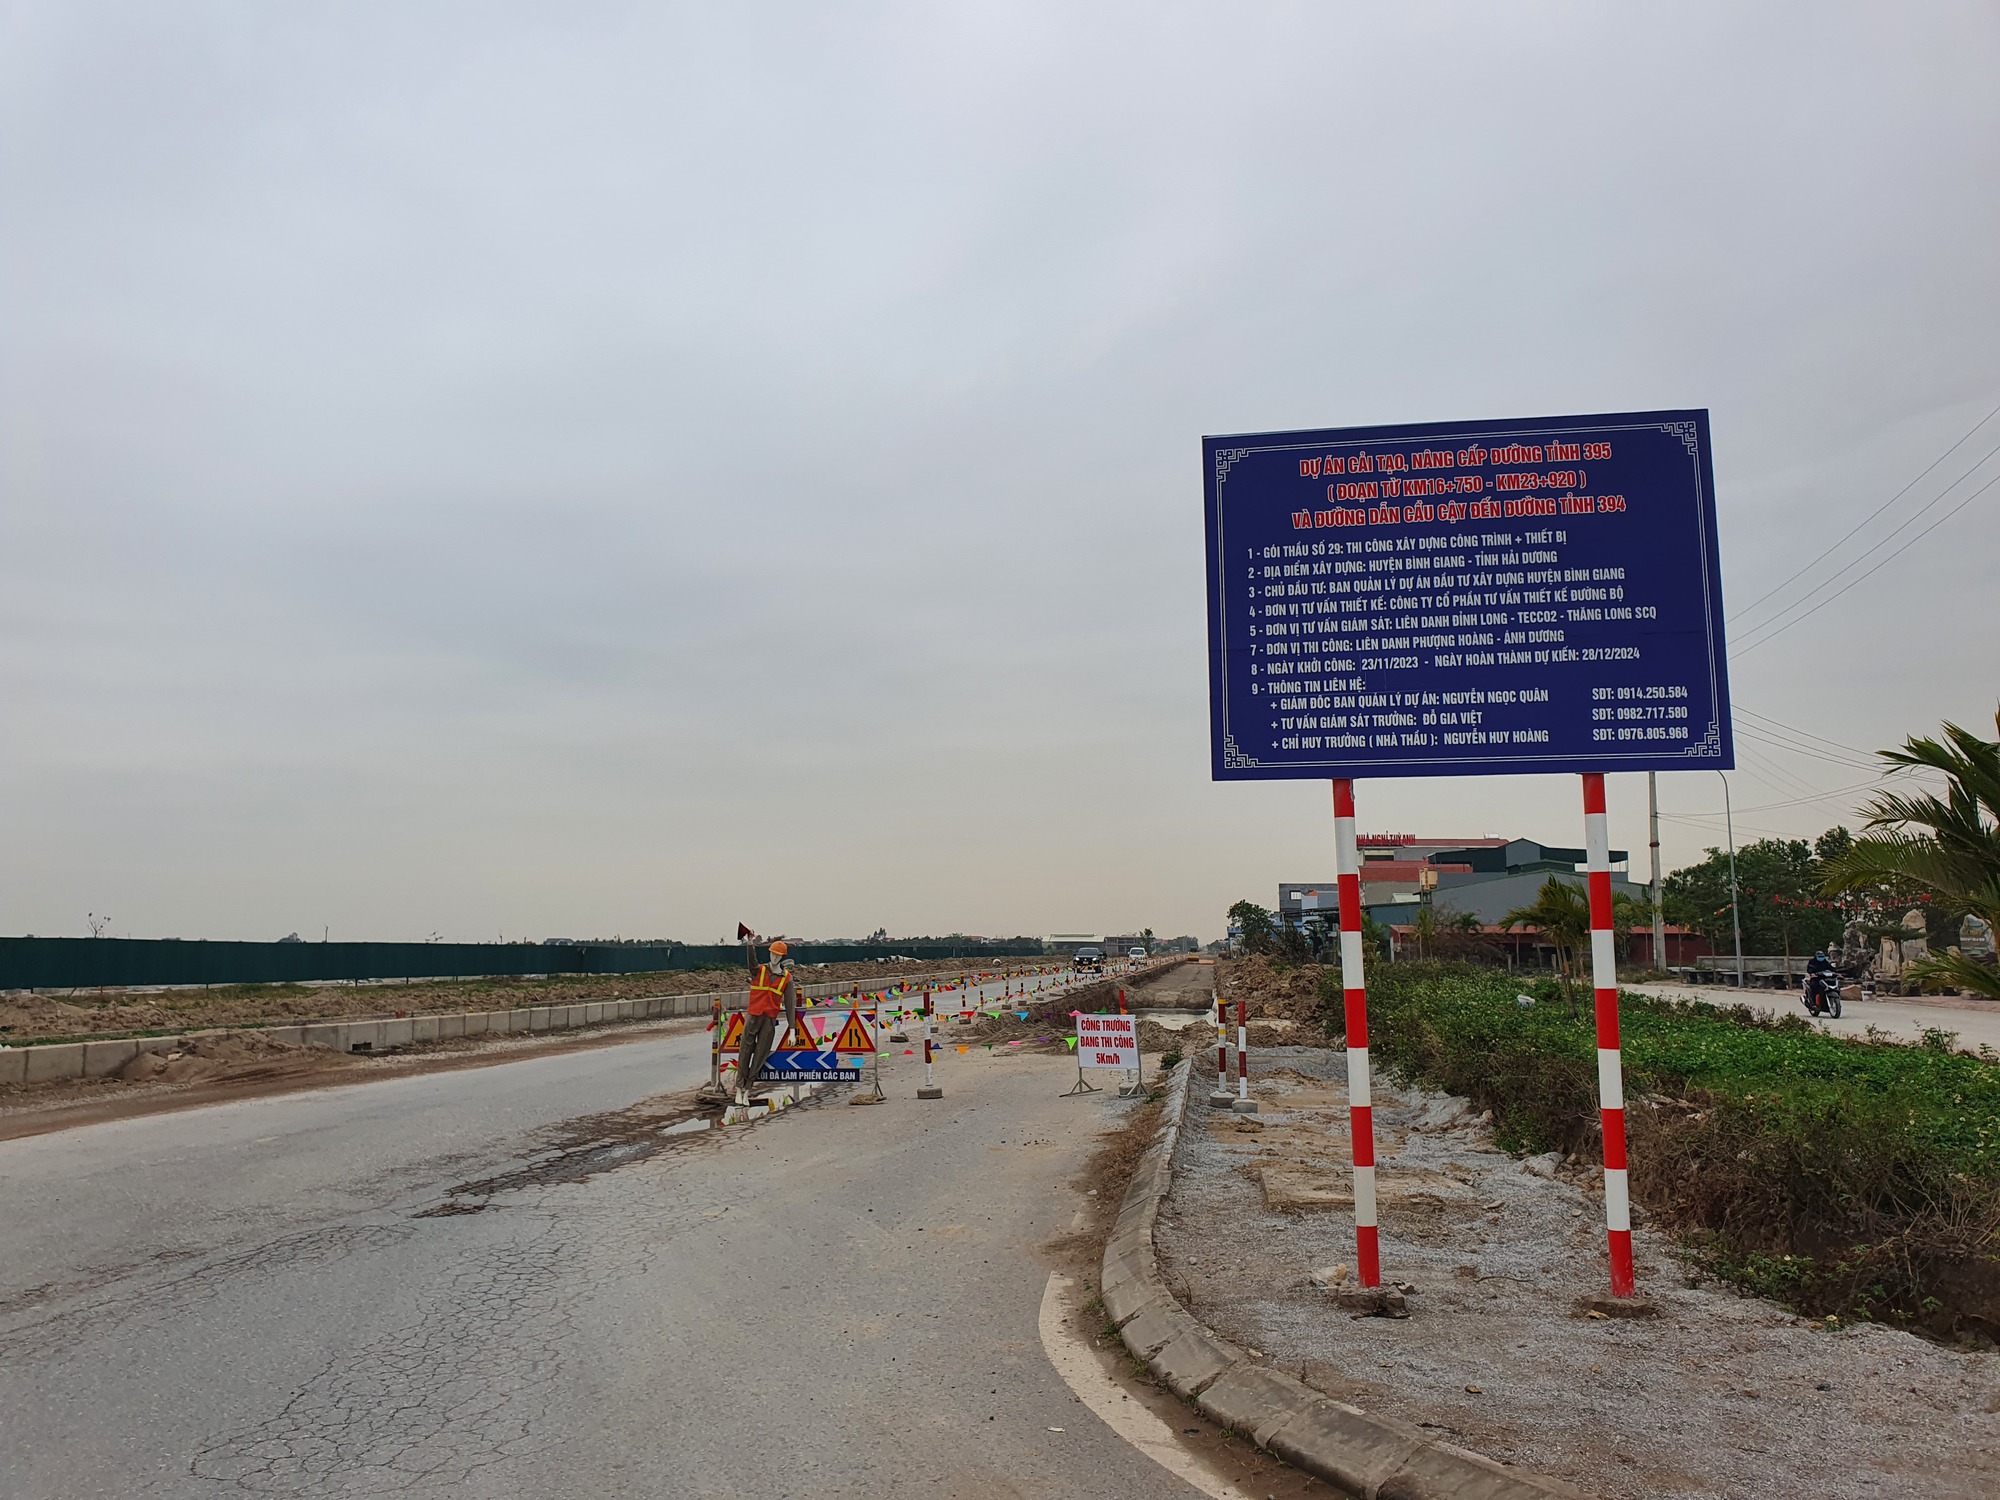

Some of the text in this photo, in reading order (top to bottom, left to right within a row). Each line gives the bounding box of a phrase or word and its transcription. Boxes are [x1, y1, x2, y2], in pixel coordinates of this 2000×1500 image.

[1300, 440, 1611, 477] DỰ ÁN CẢI TẠO, NÂNG CẤP ĐƯỜNG TỈNH 395
[1337, 471, 1576, 501] ĐOẠN TỪ KM16+750 KM23+920
[1292, 492, 1626, 528] VÀ ĐƯỜNG DẪN CẦU CẬY ĐẾN ĐƯỜNG TỈNH 394
[1263, 527, 1553, 558] GÓI THẦU 29: THI CÔNG XÂY DỰNG CÔNG TRÌNH THIẾT
[1263, 549, 1557, 580] ĐỊA ĐIỂM XÂY DỰNG: HUYỆN BÌNH GIANG TỈNH HẢI DƯƠNG
[1264, 567, 1625, 597] CHỦ ĐẦU TƯ: BAN QUẢN DỰ ÁN ĐẦU TƯ XÂY DỰNG HUYỆN BÌNH GIANG
[1264, 584, 1623, 616] ĐƠN TƯ VẤN THIẾT KẾ: CÔNG CỔ TƯ VẤN THIẾT KẾ ĐƯỜNG BỘ
[1265, 622, 1287, 636] ĐƠN
[1301, 620, 1316, 634] TƯ
[1317, 616, 1338, 633] VẤN
[1341, 617, 1368, 632] GIÁM
[1370, 615, 1392, 630] SÁT:
[1395, 614, 1418, 629] LIÊN
[1421, 615, 1450, 628] DANH
[1452, 610, 1477, 626] ĐỈNH
[1480, 612, 1508, 625] LONG
[1566, 606, 1601, 621] THĂNG
[1604, 607, 1632, 620] LONG
[1634, 606, 1656, 619] SCQ
[1266, 629, 1564, 655] ĐƠN THI CÔNG: LIÊN DANH PHƯỢNG HOÀNG ÁNH DƯƠNG
[1267, 645, 1640, 674] NGÀY KHỞI CÔNG: 23/11/2023 NGÀY HOÀN THÀNH DỰ KIẾN: 28/12/2024
[1267, 675, 1366, 694] THÔNG TIN LIÊN HỆ:
[1592, 686, 1688, 700] SĐT: 0914.250.584
[1280, 687, 1548, 710] GIÁM BAN DỰ ÁN: NGUYỄN NGỌC QUÂN
[1280, 708, 1482, 730] TƯ VẤN GIÁM SÁT TRƯỞNG: ĐỖ GIA VIỆT
[1592, 706, 1688, 720] SĐT: 0982.717.580
[1281, 727, 1549, 749] CHỈ HUY TRƯỞNG NHÀ THẦU NGUYỄN HUY HOÀNG
[1592, 726, 1688, 741] SĐT: 0976.805.968
[1081, 1017, 1131, 1032] CÔNG TRƯỜNG
[1080, 1034, 1134, 1048] ĐANG THI CÔNG
[1096, 1053, 1120, 1065] 5Km/h
[823, 1069, 838, 1080] CÁC
[840, 1071, 856, 1082] BẠN
